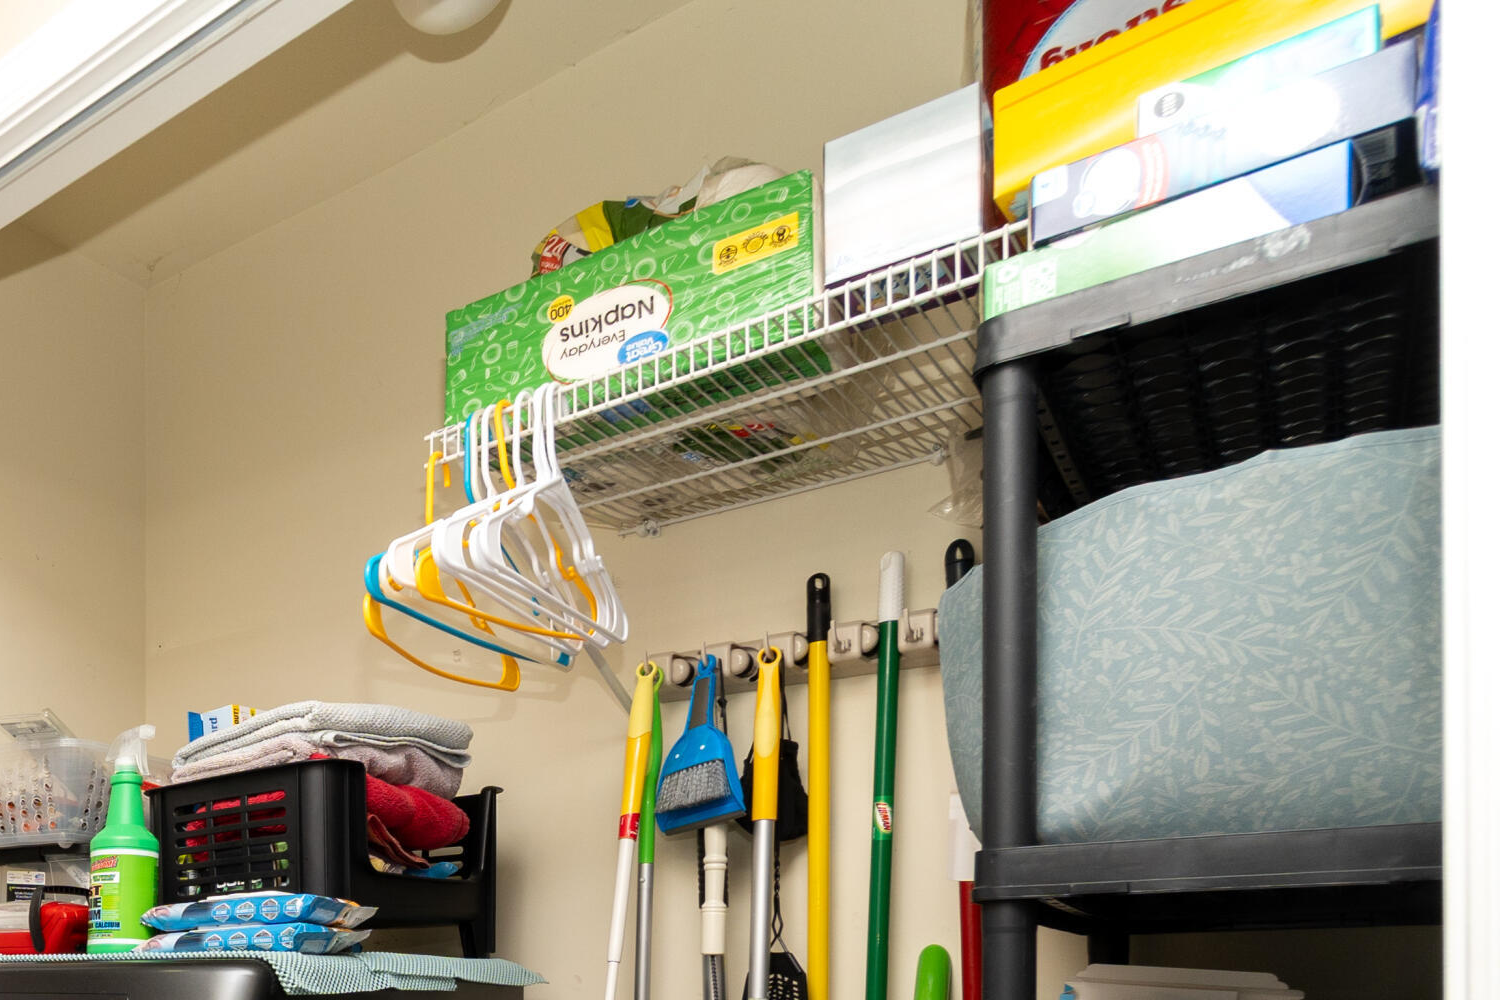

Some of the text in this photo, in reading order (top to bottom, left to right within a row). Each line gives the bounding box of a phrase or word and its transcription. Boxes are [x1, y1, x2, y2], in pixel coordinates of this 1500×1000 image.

[550, 303, 573, 321] 400
[560, 296, 655, 342] Napkins
[560, 329, 626, 361] Everyday
[625, 341, 663, 362] Great
